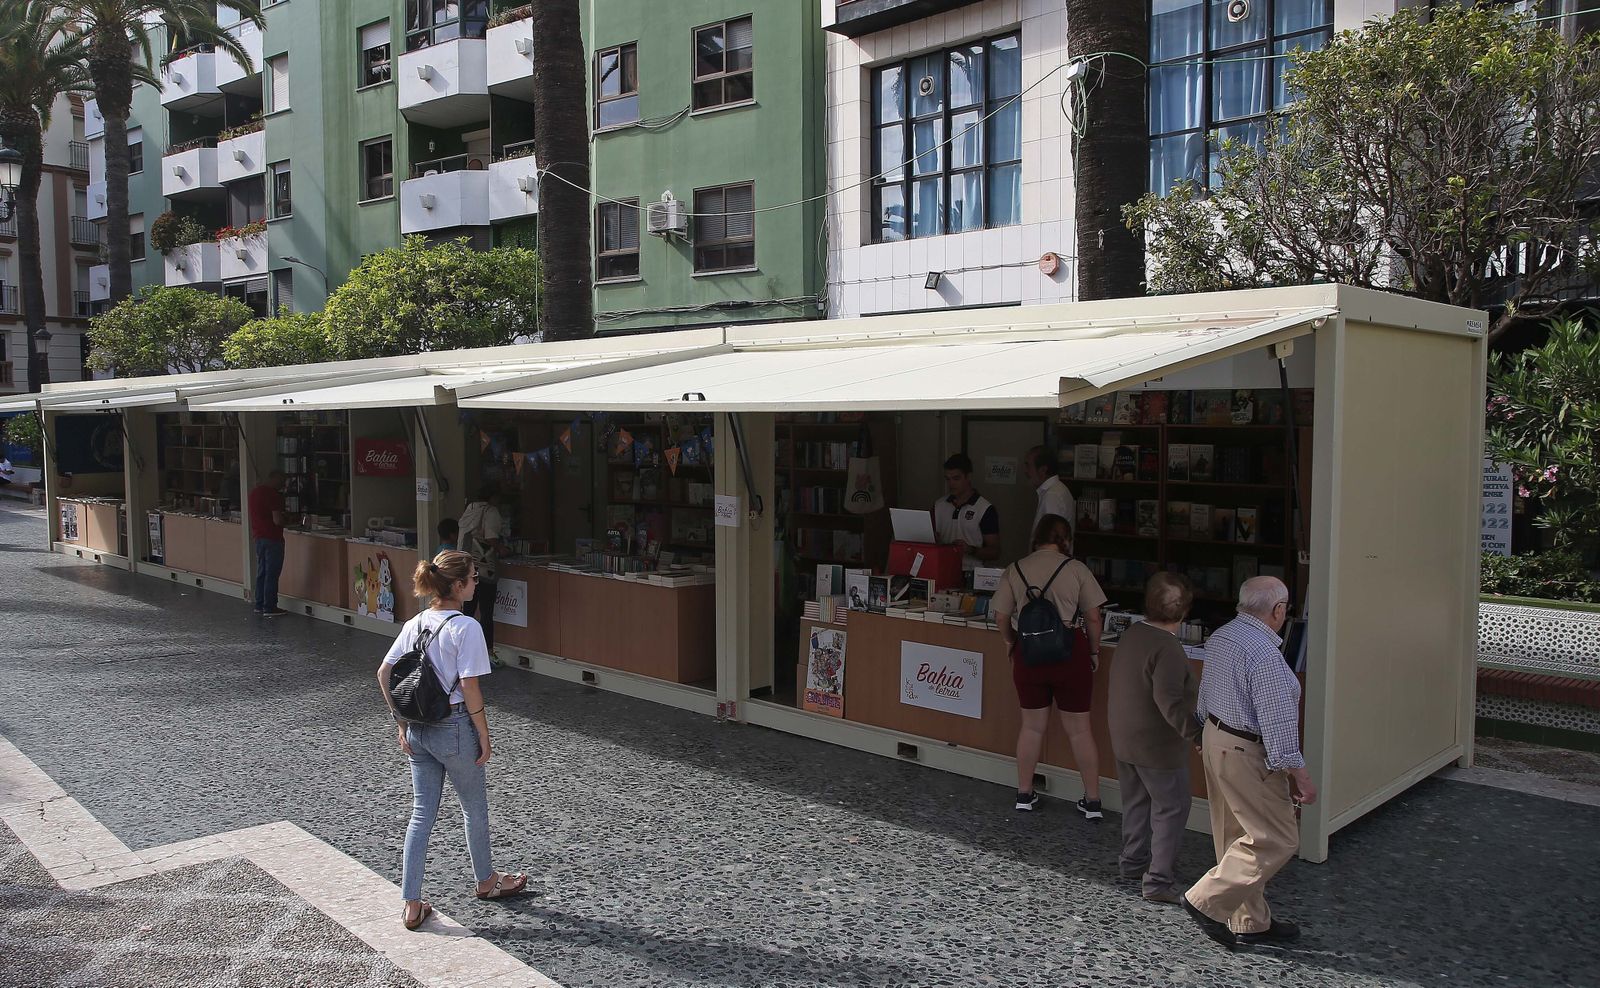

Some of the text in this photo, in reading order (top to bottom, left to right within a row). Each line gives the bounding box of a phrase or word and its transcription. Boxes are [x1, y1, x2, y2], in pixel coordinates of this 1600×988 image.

[365, 449, 399, 463] Bahía
[1482, 502, 1507, 514] 22
[916, 662, 965, 690] Bahía
[935, 683, 961, 698] letras
